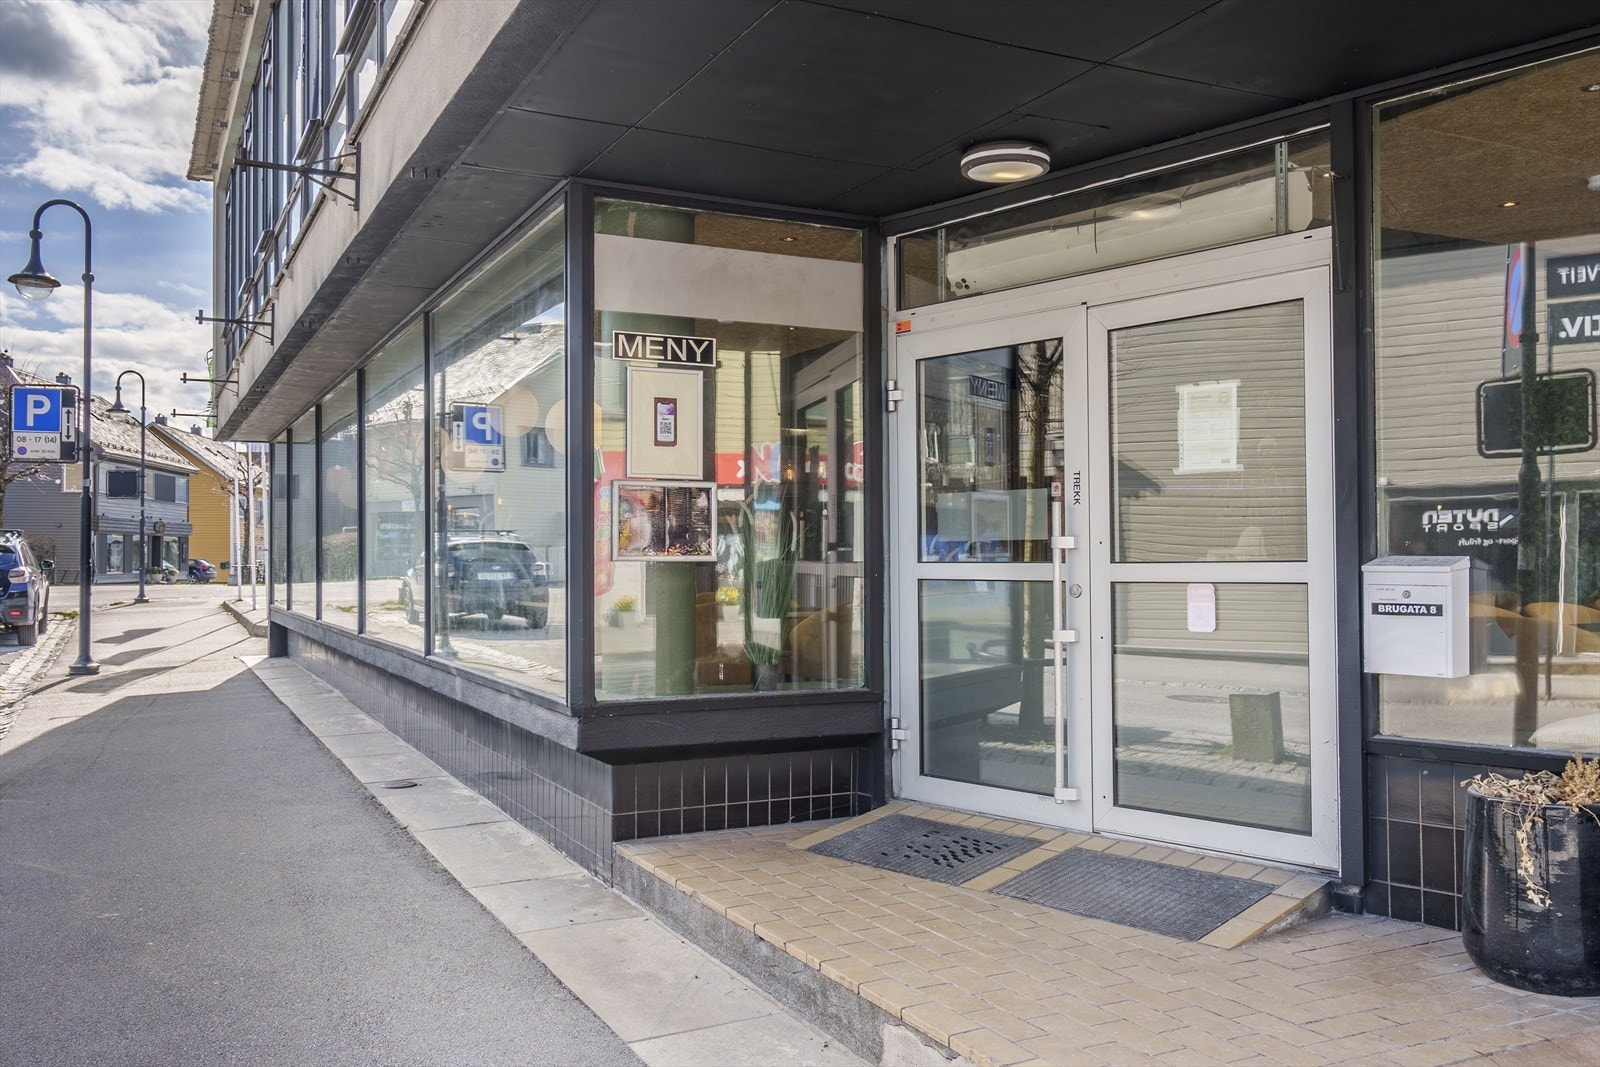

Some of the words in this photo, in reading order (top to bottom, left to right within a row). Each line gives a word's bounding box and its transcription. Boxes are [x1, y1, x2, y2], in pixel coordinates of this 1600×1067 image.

[618, 334, 710, 362] MENY
[26, 394, 51, 427] P
[44, 436, 56, 444] (14)
[1073, 470, 1081, 506] TREKK
[1378, 604, 1428, 614] BRUGATA
[1429, 605, 1437, 614] 8
